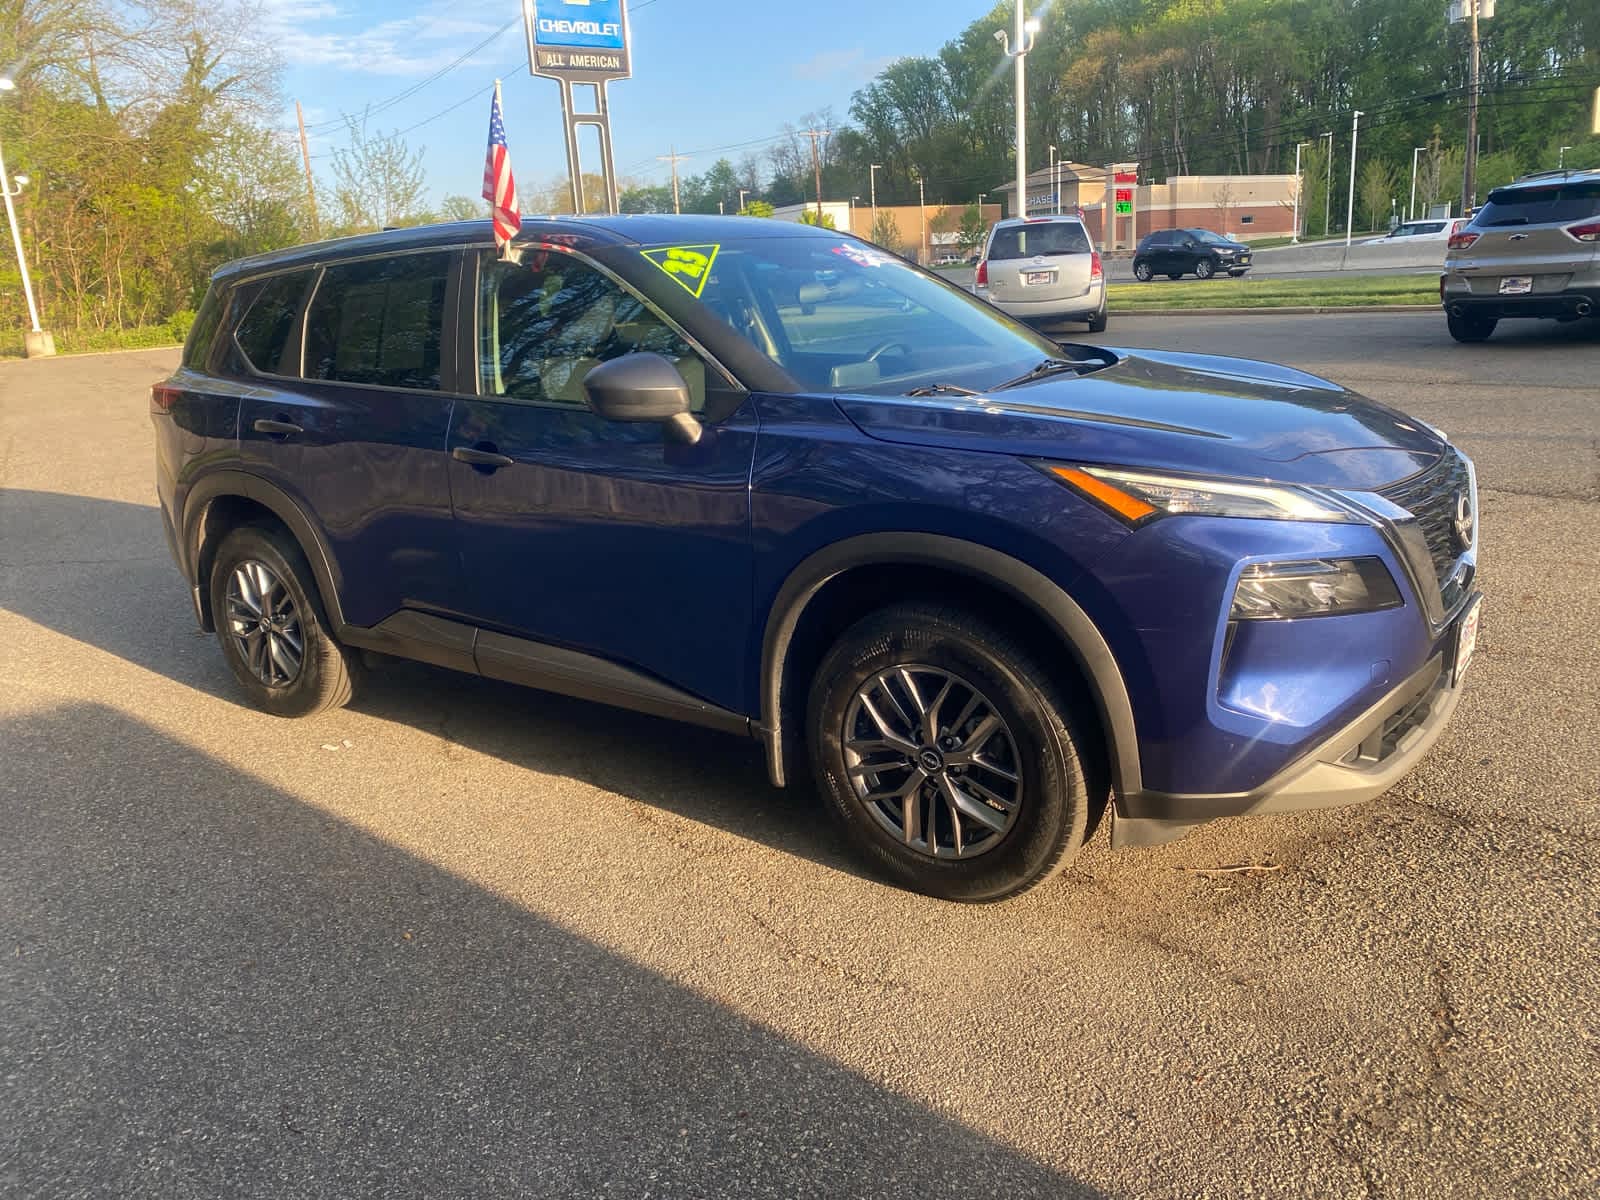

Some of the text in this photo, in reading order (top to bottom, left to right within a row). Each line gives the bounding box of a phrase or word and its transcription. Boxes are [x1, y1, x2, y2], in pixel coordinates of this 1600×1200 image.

[540, 19, 620, 36] CHEVROLET
[546, 54, 619, 68] ALL AMERICAN
[1029, 194, 1053, 205] HASE
